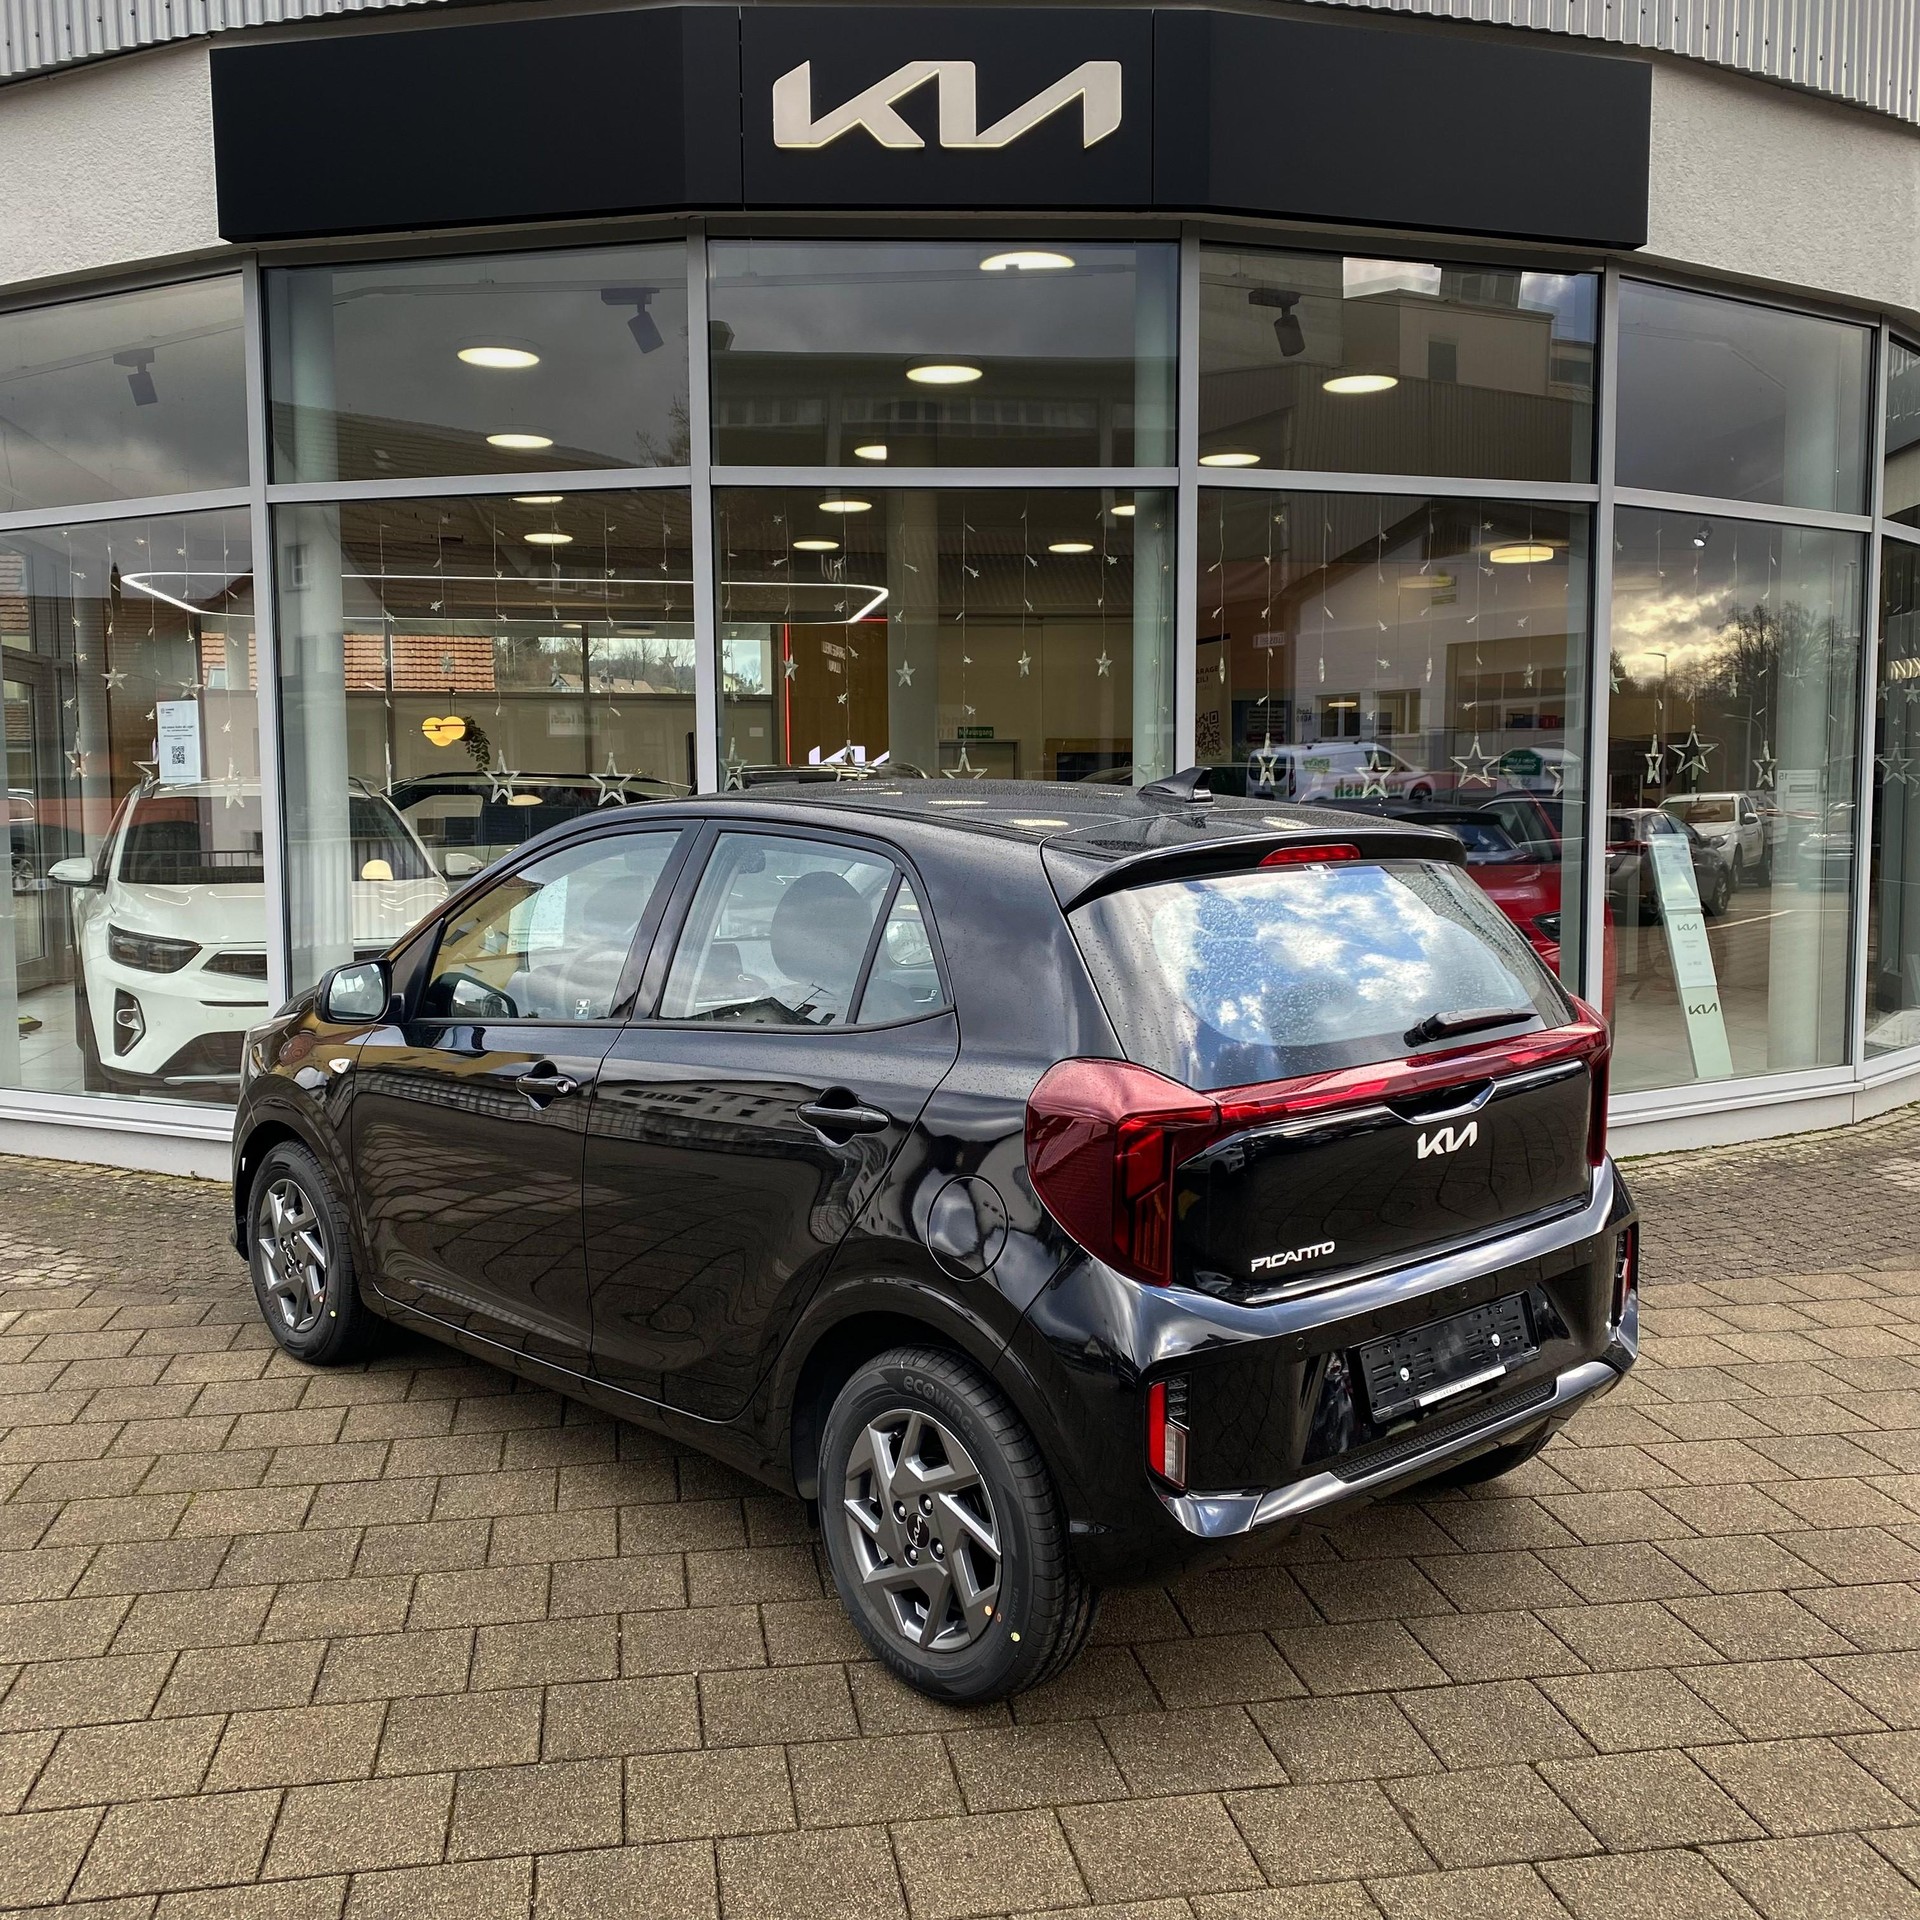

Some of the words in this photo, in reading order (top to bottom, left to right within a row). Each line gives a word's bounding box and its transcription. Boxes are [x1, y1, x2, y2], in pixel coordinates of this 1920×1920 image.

[772, 60, 1123, 149] KIA
[1196, 665, 1219, 674] ARAGE
[1677, 923, 1698, 931] KIA
[1688, 1002, 1718, 1015] KIA
[1417, 1121, 1478, 1159] KIA
[1251, 1240, 1336, 1273] PICANTO
